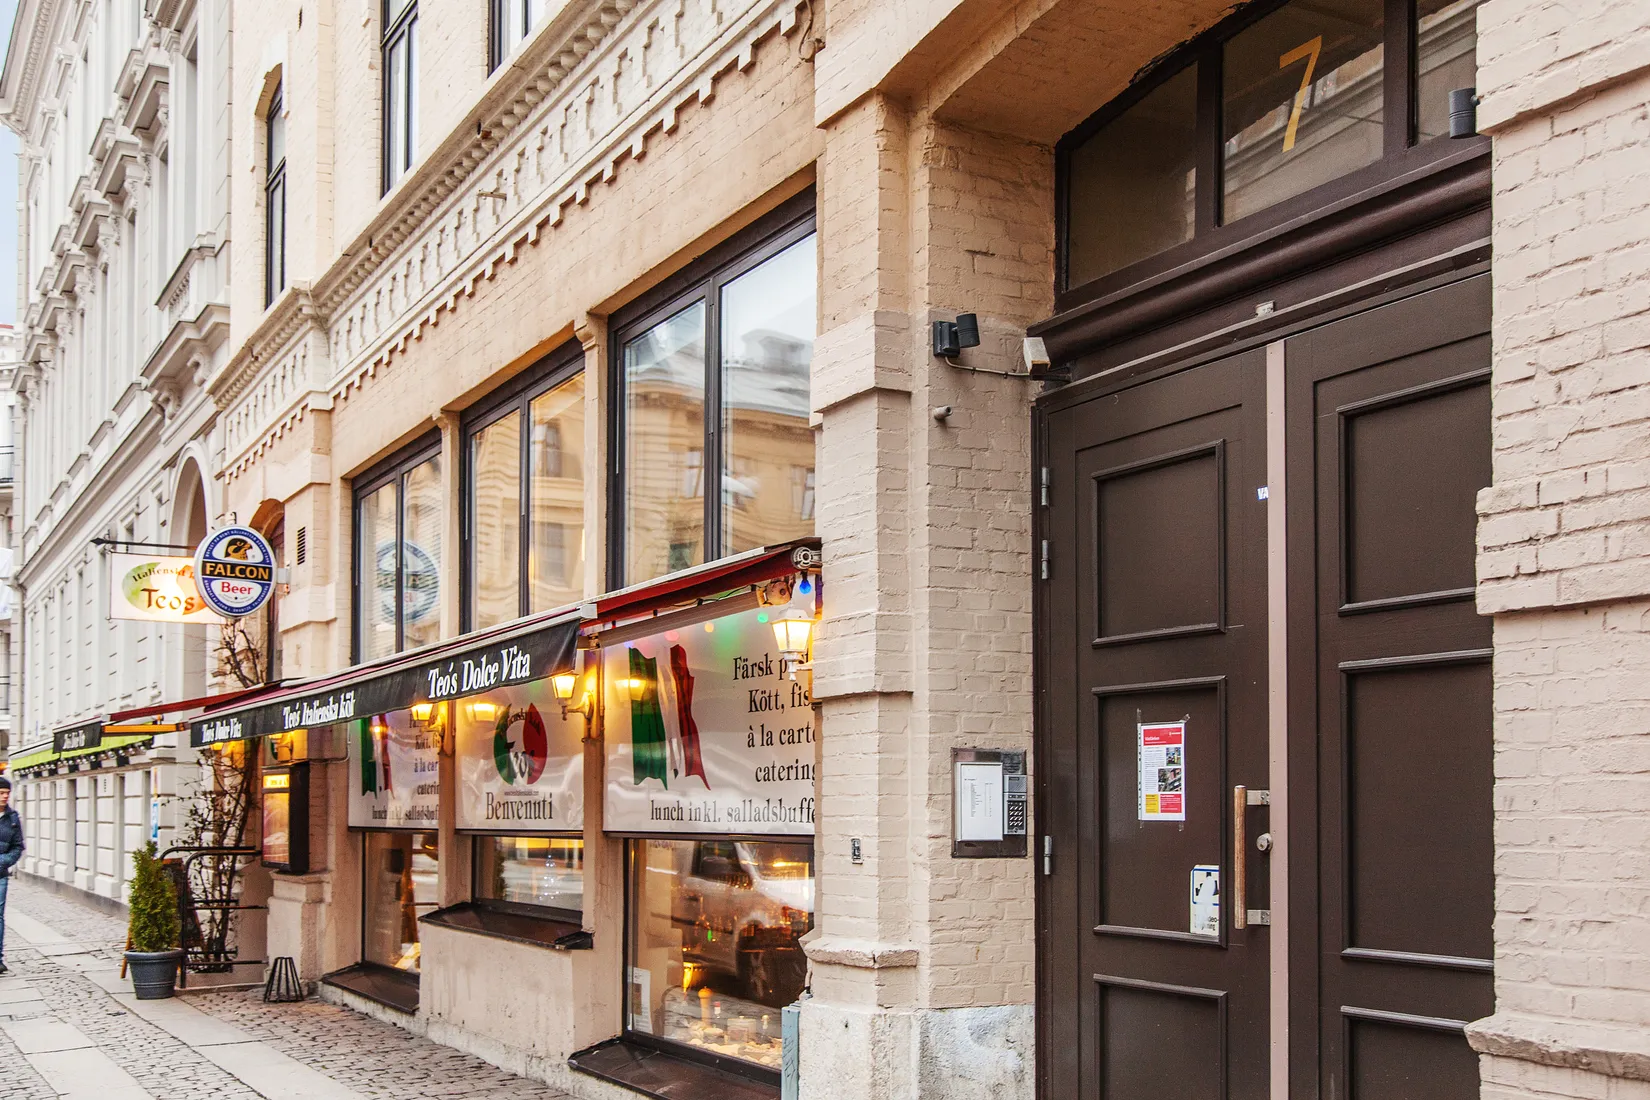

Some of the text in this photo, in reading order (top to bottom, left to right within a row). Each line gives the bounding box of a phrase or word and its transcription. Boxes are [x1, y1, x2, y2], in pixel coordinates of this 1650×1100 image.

[1280, 35, 1322, 153] 7
[205, 562, 269, 580] FALCON
[140, 587, 195, 611] Teos
[221, 581, 253, 595] Beer
[428, 645, 531, 699] Teo's Dolce Vita
[732, 652, 774, 681] Färsk
[301, 695, 340, 727] Italienska
[748, 688, 785, 714] Kött,
[747, 725, 755, 748] à
[760, 723, 774, 747] la
[485, 791, 553, 821] Benvenuti
[650, 800, 684, 821] lunch
[688, 800, 721, 823] inkl.
